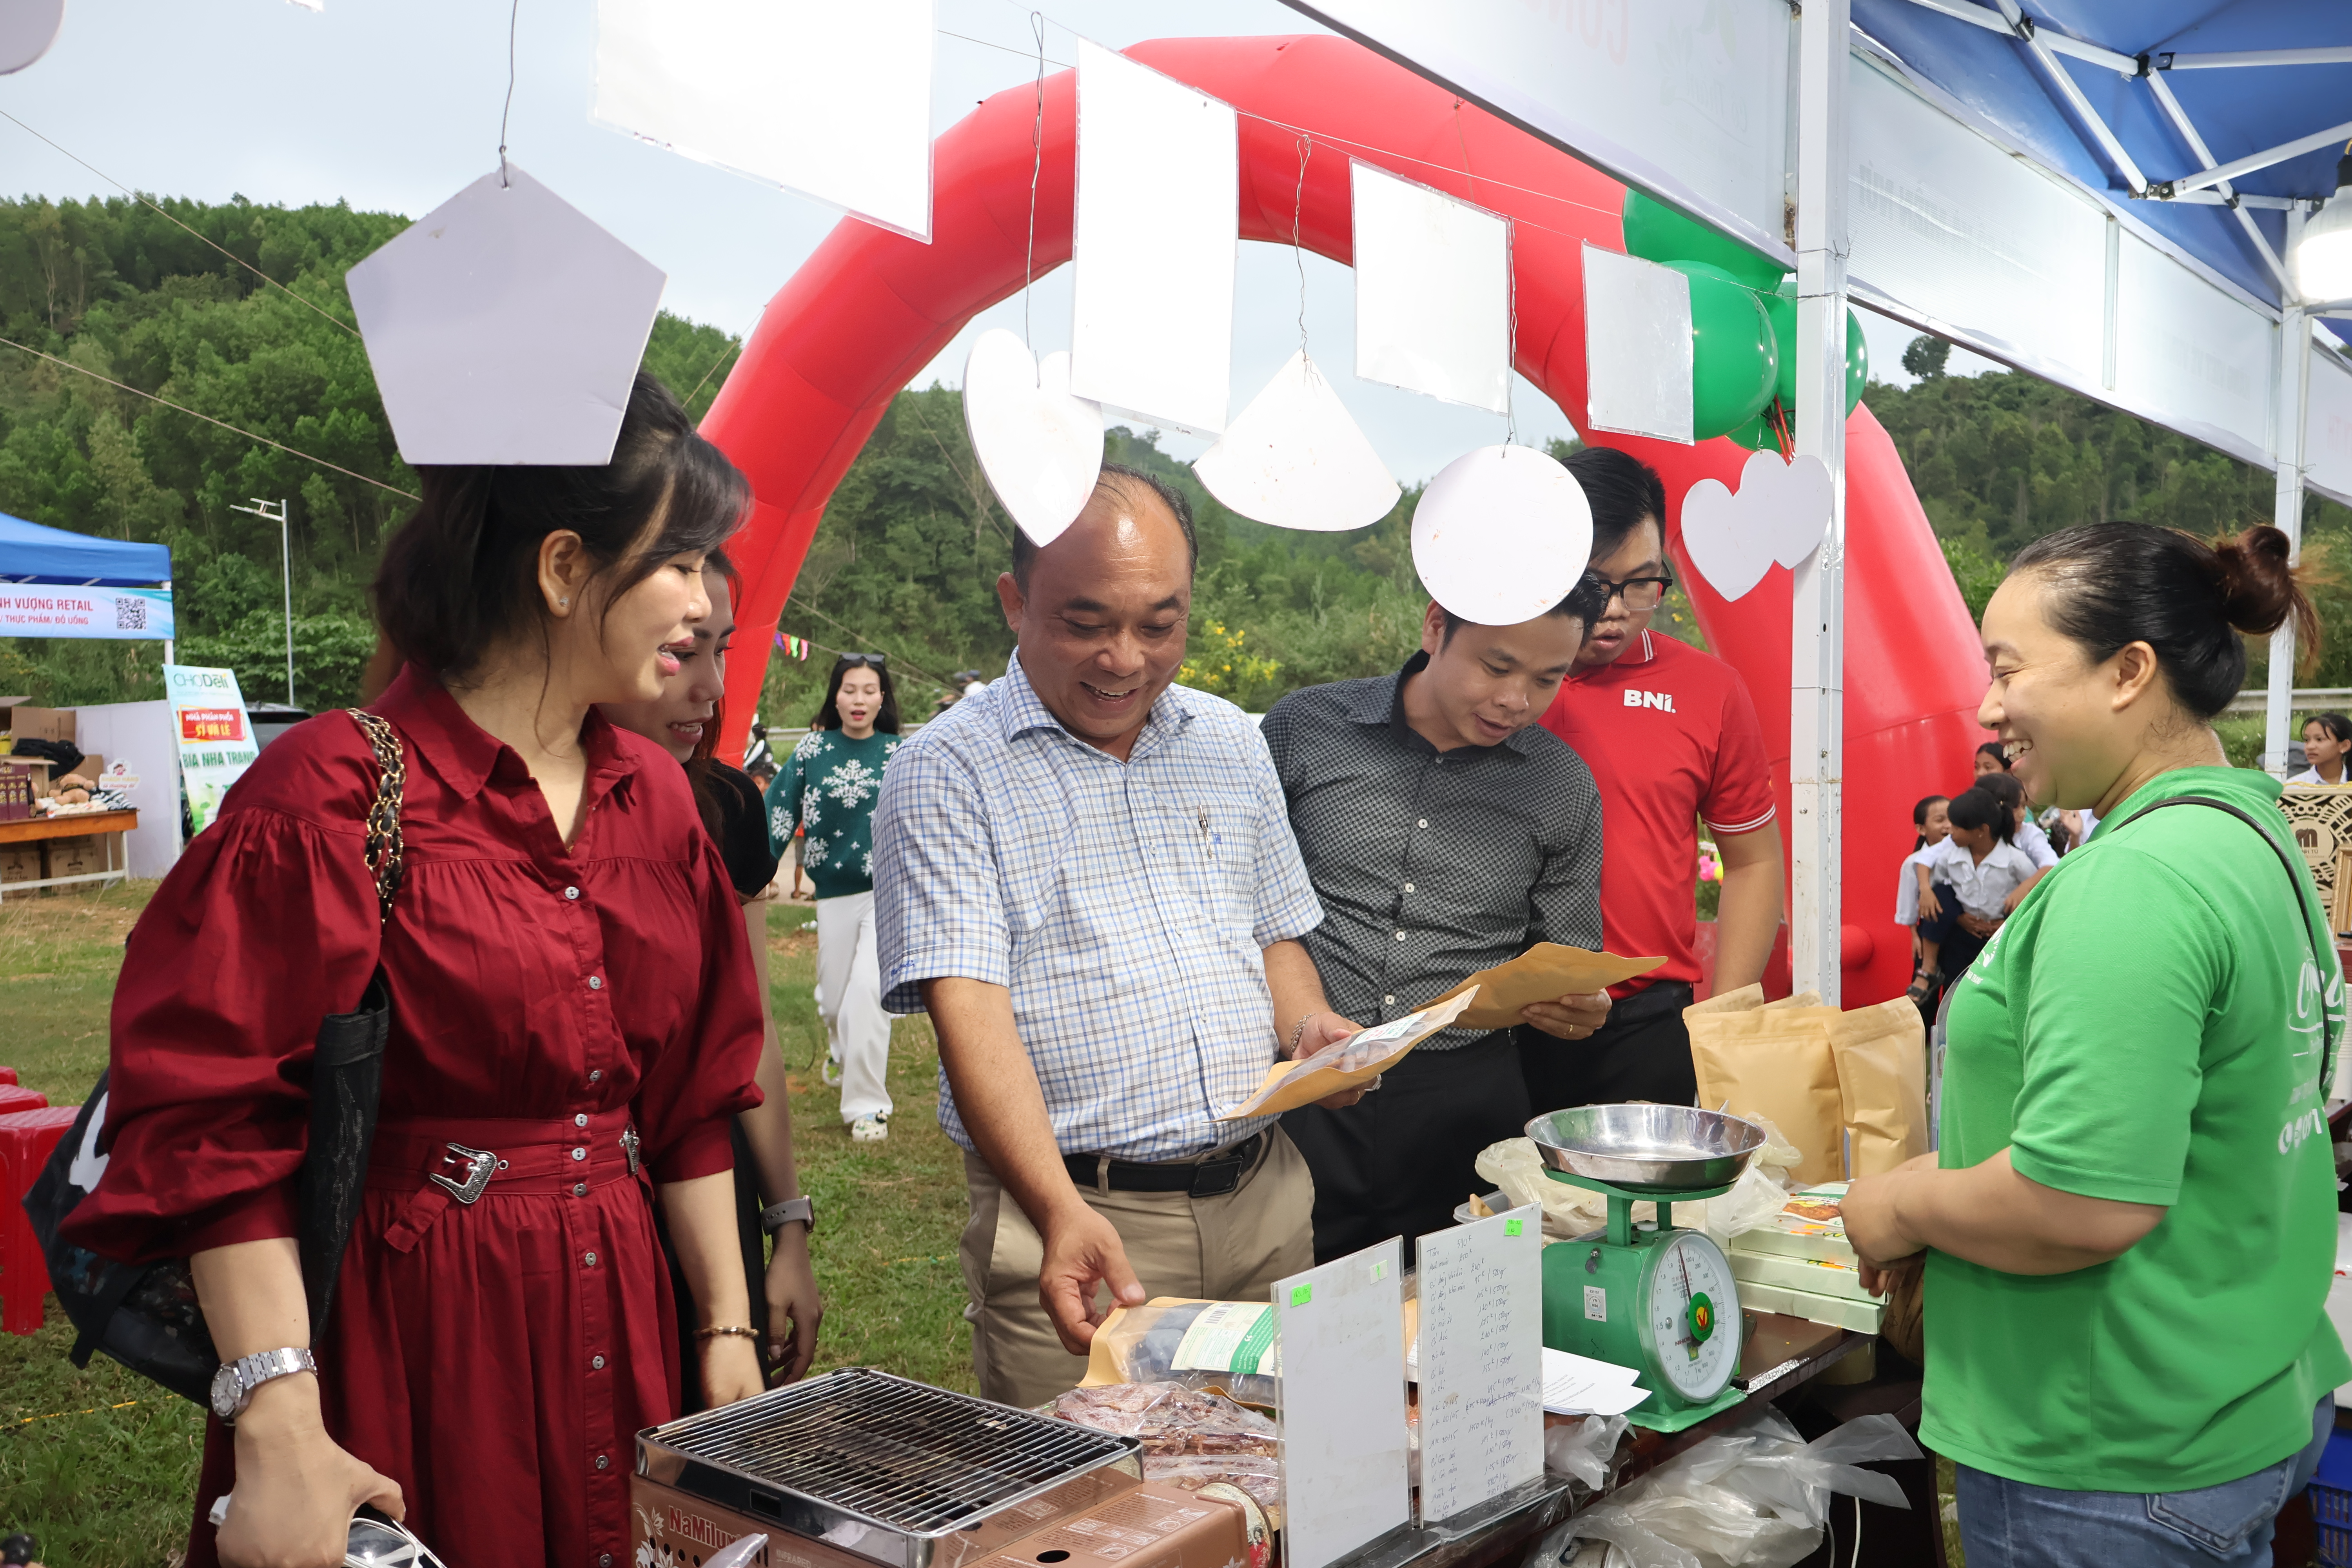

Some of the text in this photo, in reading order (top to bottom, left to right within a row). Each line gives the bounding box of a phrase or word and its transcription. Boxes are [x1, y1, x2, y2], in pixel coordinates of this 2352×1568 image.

[15, 596, 53, 612] VƯỢNG
[57, 599, 93, 611] RETAIL
[182, 753, 199, 768] BIA
[201, 751, 224, 767] NHA
